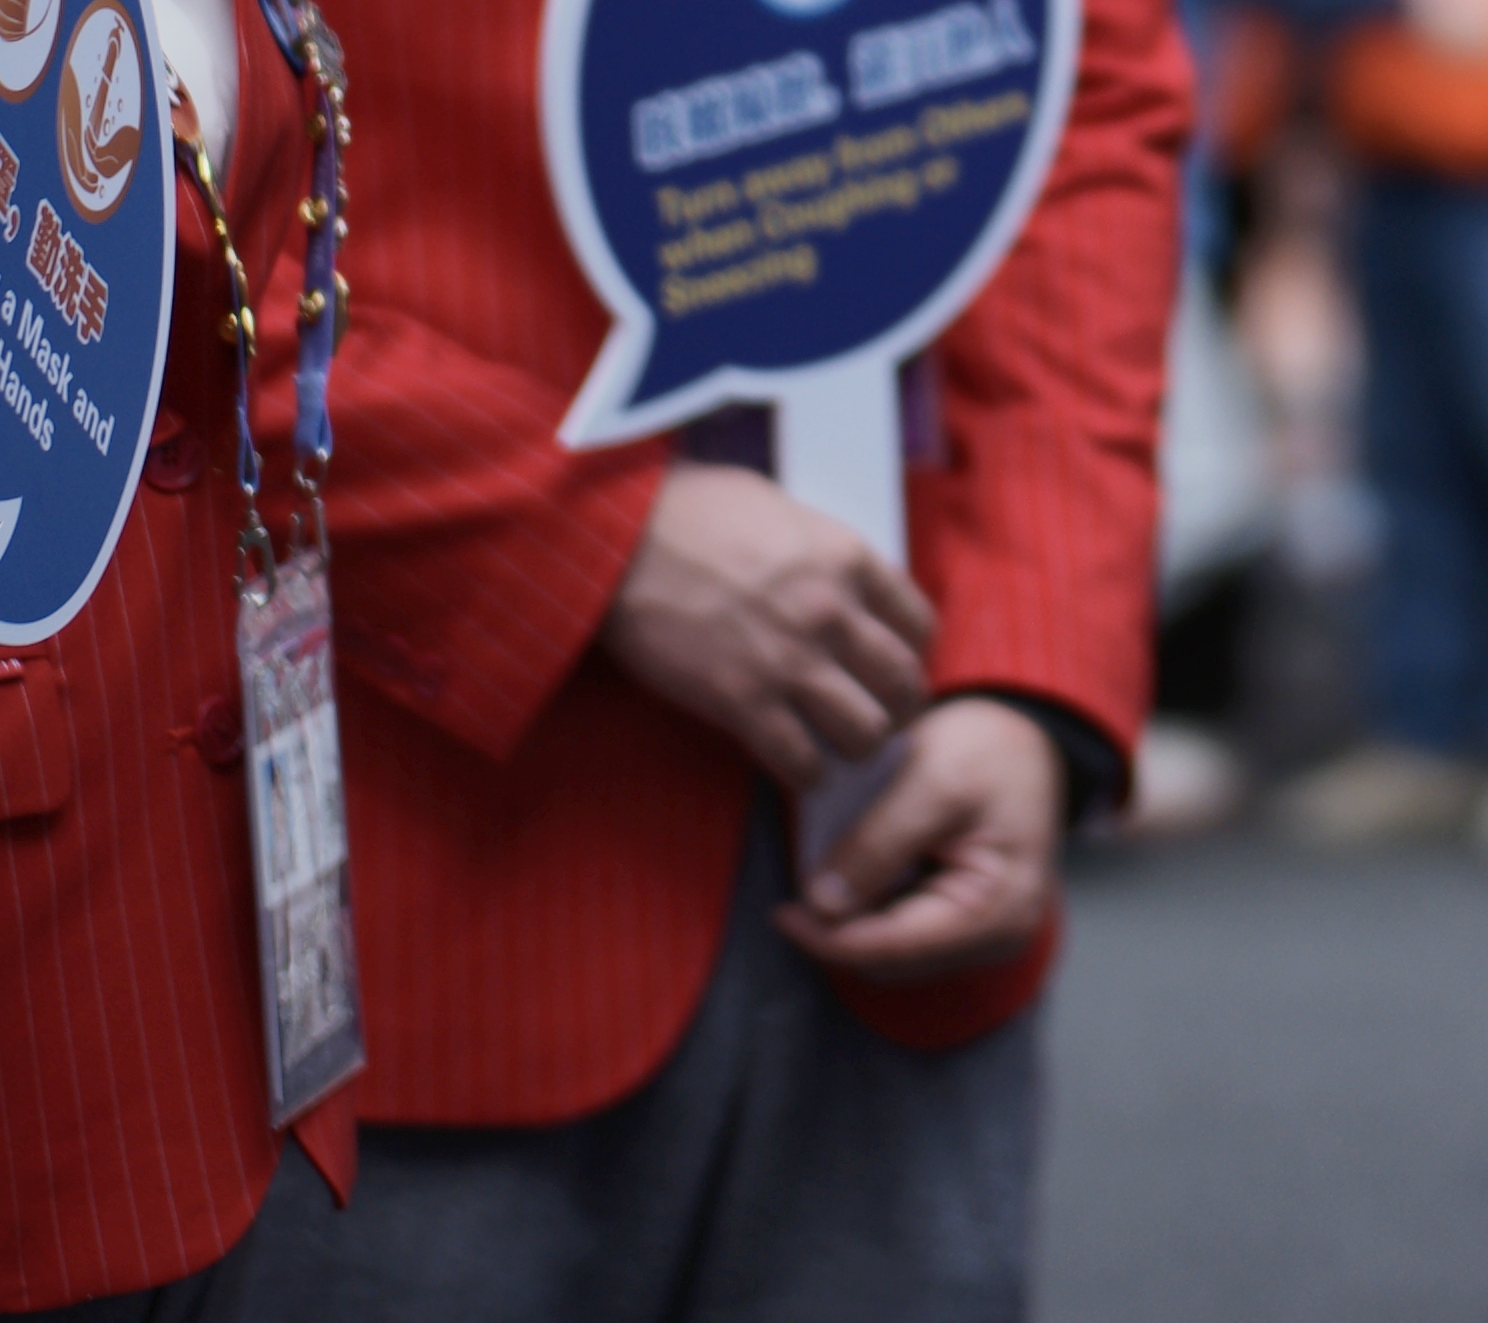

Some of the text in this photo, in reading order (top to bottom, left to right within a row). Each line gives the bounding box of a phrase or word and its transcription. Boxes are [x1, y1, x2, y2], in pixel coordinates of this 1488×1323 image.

[0, 289, 18, 327] a
[17, 298, 74, 404] Mask
[72, 386, 116, 456] and
